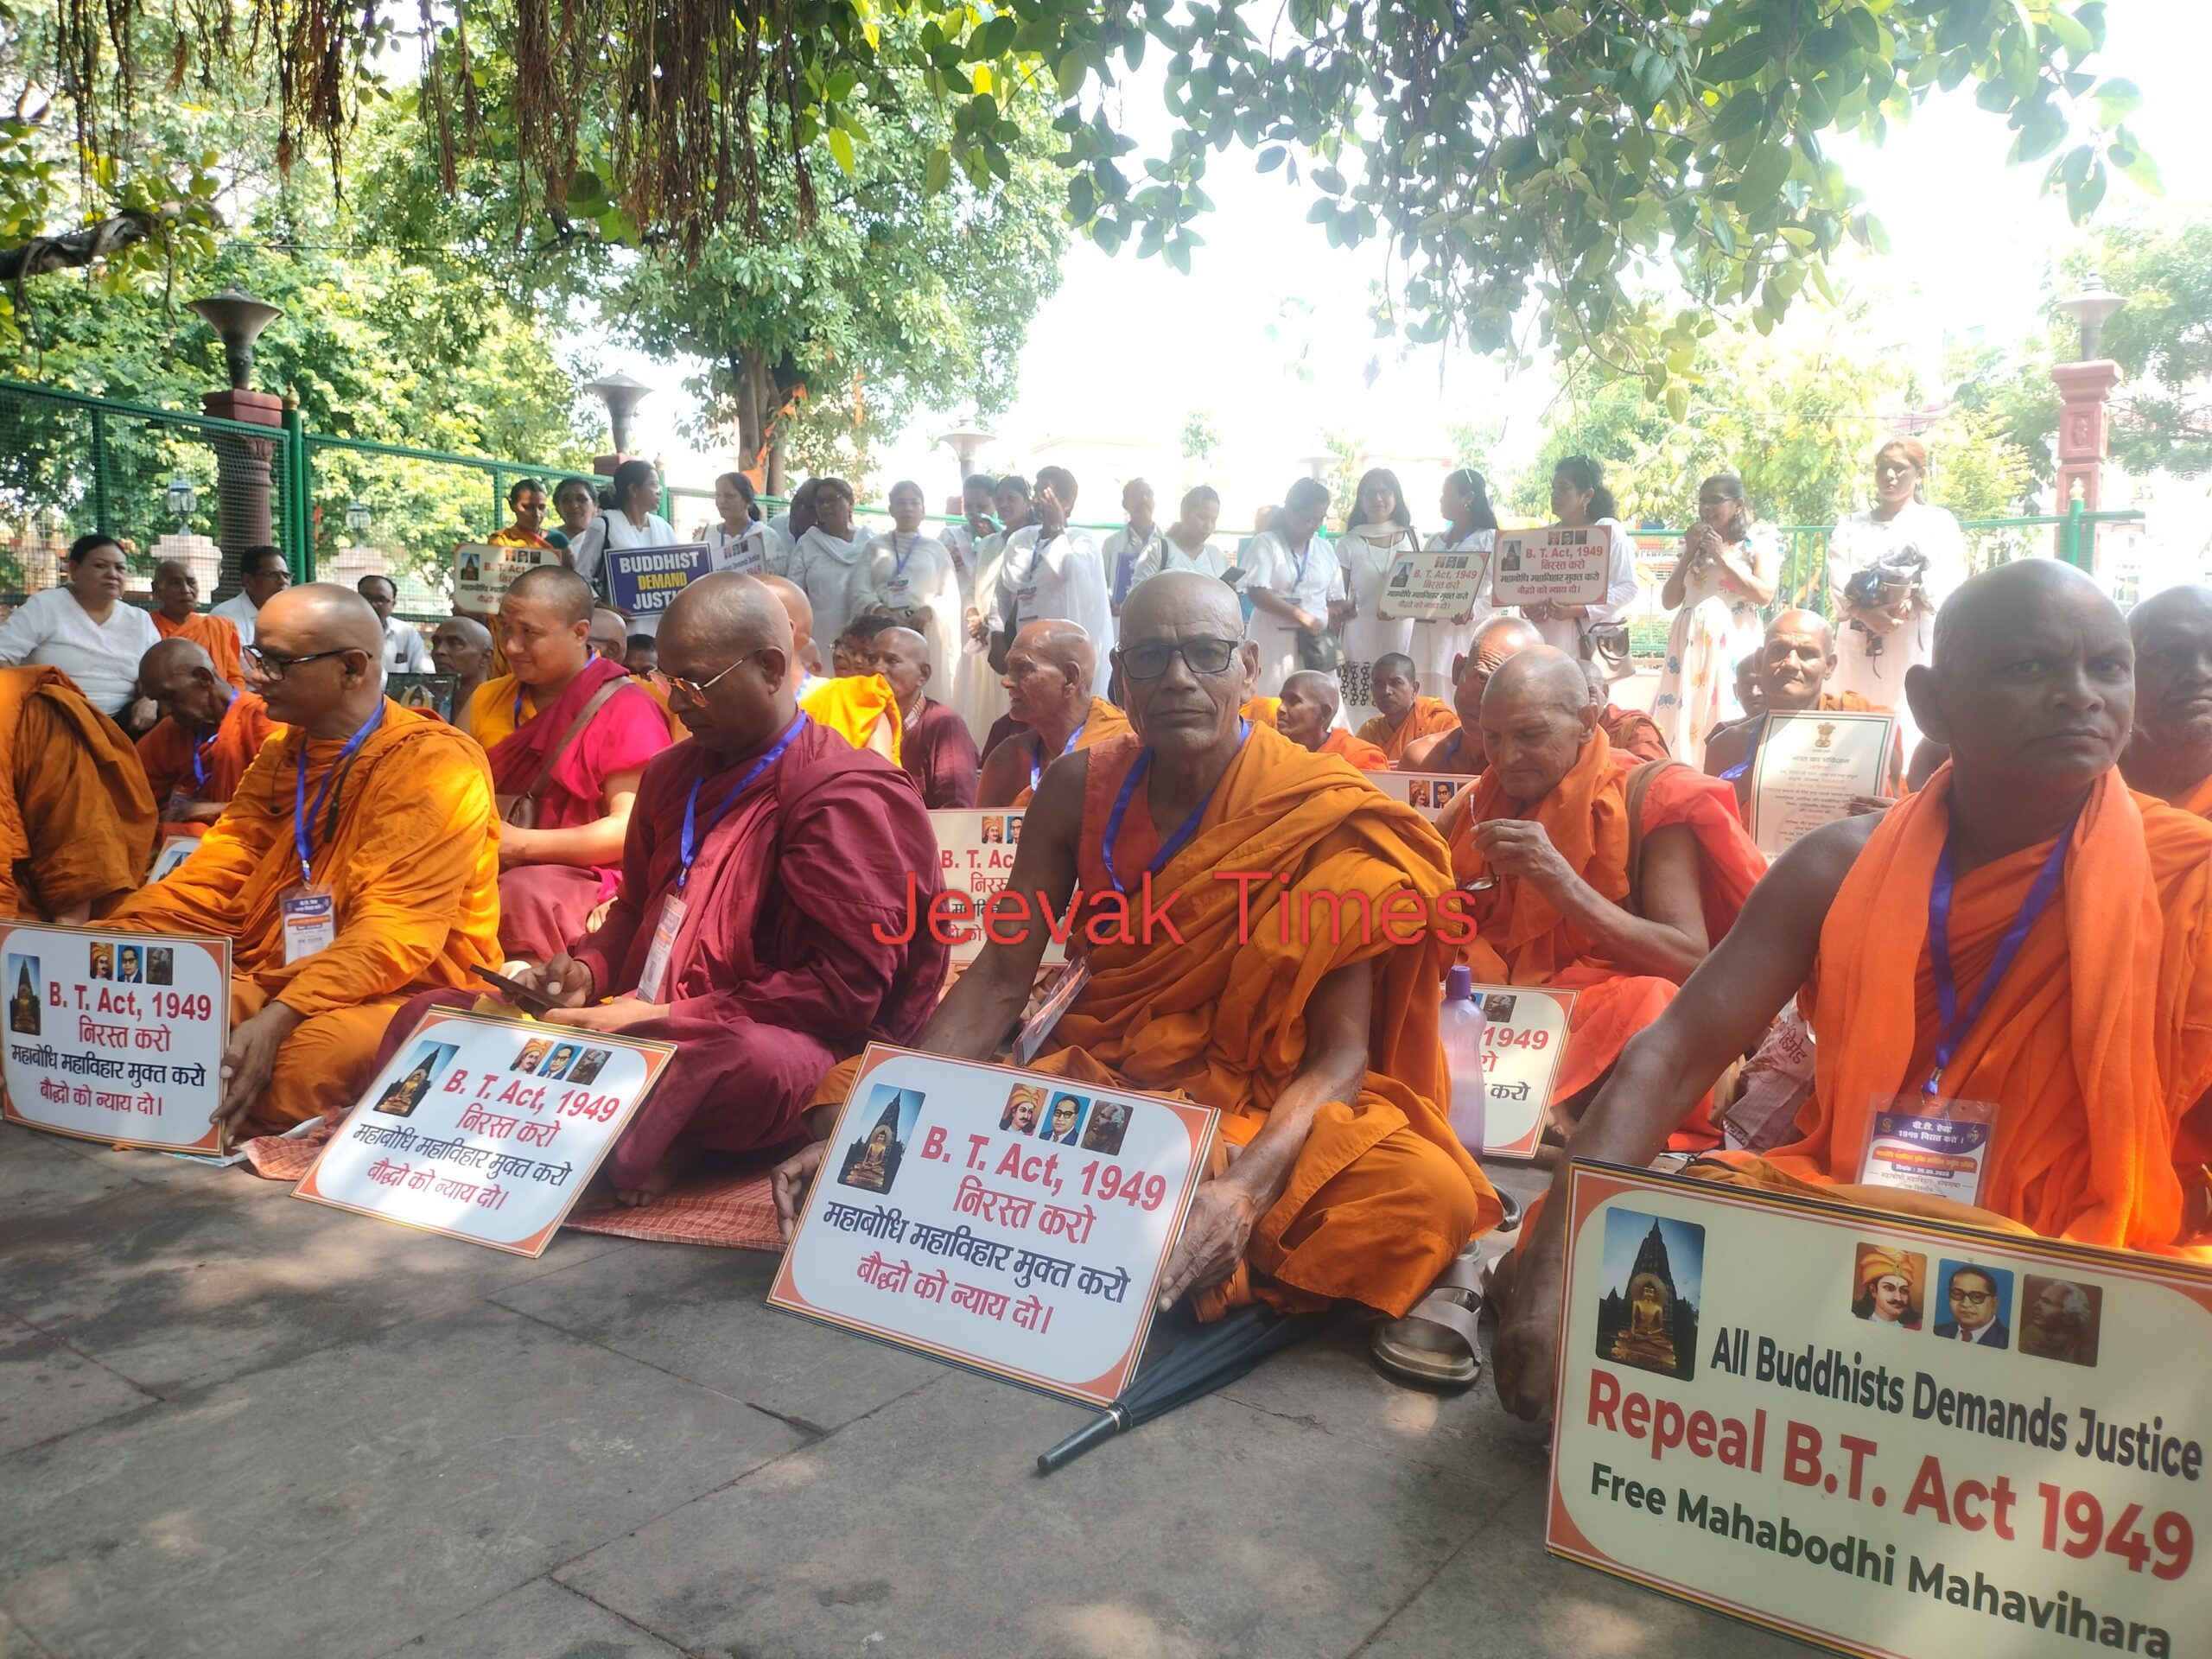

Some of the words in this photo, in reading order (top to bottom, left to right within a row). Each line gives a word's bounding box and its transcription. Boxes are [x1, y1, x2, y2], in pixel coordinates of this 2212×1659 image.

[484, 562, 494, 571] B.
[508, 563, 525, 574] Act
[619, 551, 699, 574] BUDDHIST
[1525, 549, 1535, 558] B.
[1540, 548, 1548, 557] T.
[1551, 547, 1573, 559] Act,
[1577, 546, 1603, 556] 1949
[1541, 558, 1567, 570] निरस्त
[1568, 558, 1586, 570] करो
[638, 571, 687, 591] DEMAND
[1434, 570, 1452, 580] Act,
[1456, 570, 1478, 579] 1949
[1537, 585, 1548, 594] को
[1565, 573, 1583, 584] मुक्त
[1585, 571, 1600, 582] करो
[632, 589, 677, 611] JUST
[941, 849, 959, 869] B.
[966, 849, 982, 869] T.
[988, 849, 1014, 869] Ac
[49, 982, 67, 1007] B.
[74, 984, 90, 1011] T.
[97, 988, 143, 1022] Act,
[152, 991, 212, 1021] 1949
[79, 1014, 130, 1049] निरस्त
[135, 1023, 172, 1052] करो
[1483, 1027, 1549, 1051] 1949
[11, 1043, 58, 1070] महाबोधि
[60, 1051, 125, 1079] महाविहार
[128, 1062, 168, 1089] मुक्त
[171, 1062, 207, 1087] करो
[40, 1076, 71, 1104] बौद्धो
[73, 1084, 92, 1108] को
[96, 1091, 132, 1113] न्याय
[137, 1091, 162, 1116] दो।
[443, 1069, 469, 1095] B.
[475, 1074, 499, 1100] T.
[496, 1079, 547, 1116] Act,
[556, 1090, 620, 1122] 1949
[1490, 1081, 1532, 1102] करो
[455, 1103, 520, 1139] निरस्त
[517, 1119, 562, 1147] करो
[353, 1123, 421, 1152] महाबोधि
[415, 1137, 493, 1169] महाविहार
[486, 1153, 535, 1180] मुक्त
[532, 1161, 573, 1187] करो
[920, 1125, 951, 1164] B.
[966, 1134, 990, 1171] T.
[995, 1142, 1063, 1198] Act,
[1080, 1160, 1166, 1211] 1949
[367, 1157, 411, 1187] बौद्धो
[408, 1168, 436, 1192] को
[435, 1178, 480, 1204] न्याय
[476, 1184, 510, 1211] दो।
[952, 1174, 1037, 1230] निरस्त
[1038, 1204, 1097, 1245] करो
[823, 1201, 909, 1244] महाबोधि
[909, 1223, 1014, 1272] महाविहार
[1013, 1249, 1076, 1289] मुक्त
[1077, 1265, 1132, 1304] करो
[856, 1250, 913, 1294] बौद्धो
[913, 1268, 950, 1304] को
[950, 1282, 1011, 1322] न्याय
[1012, 1294, 1054, 1335] दो।
[1710, 1326, 1750, 1376] All
[1755, 1336, 1905, 1414] Buddhists
[1911, 1370, 2069, 1452] Demands
[2075, 1406, 2203, 1482] Justice
[1586, 1368, 1767, 1474] Repeal
[1783, 1420, 1887, 1508] B.T.
[1902, 1454, 2018, 1541] Act
[2037, 1481, 2195, 1581] 1949
[1591, 1461, 1667, 1516] Free
[1676, 1487, 1897, 1586] Mahabodhi
[1907, 1554, 2172, 1659] Mahavihara
